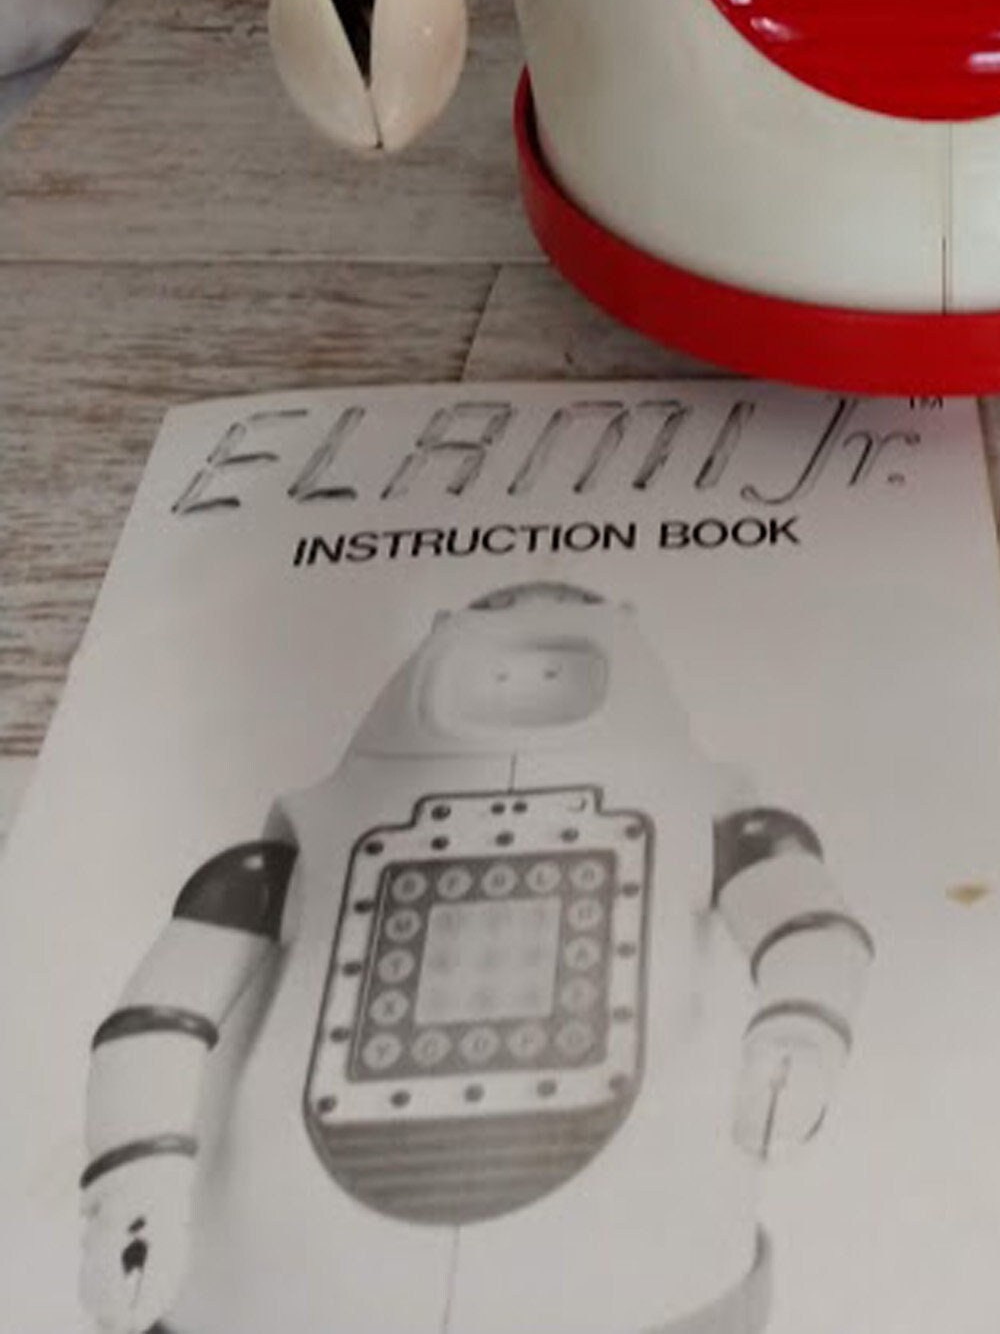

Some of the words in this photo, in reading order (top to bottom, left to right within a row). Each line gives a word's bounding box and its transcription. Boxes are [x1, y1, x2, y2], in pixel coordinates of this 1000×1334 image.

[171, 399, 755, 514] ELAMI
[738, 397, 922, 505] Jr.
[293, 522, 637, 566] INSTRUCTION
[658, 516, 800, 551] BOOK
